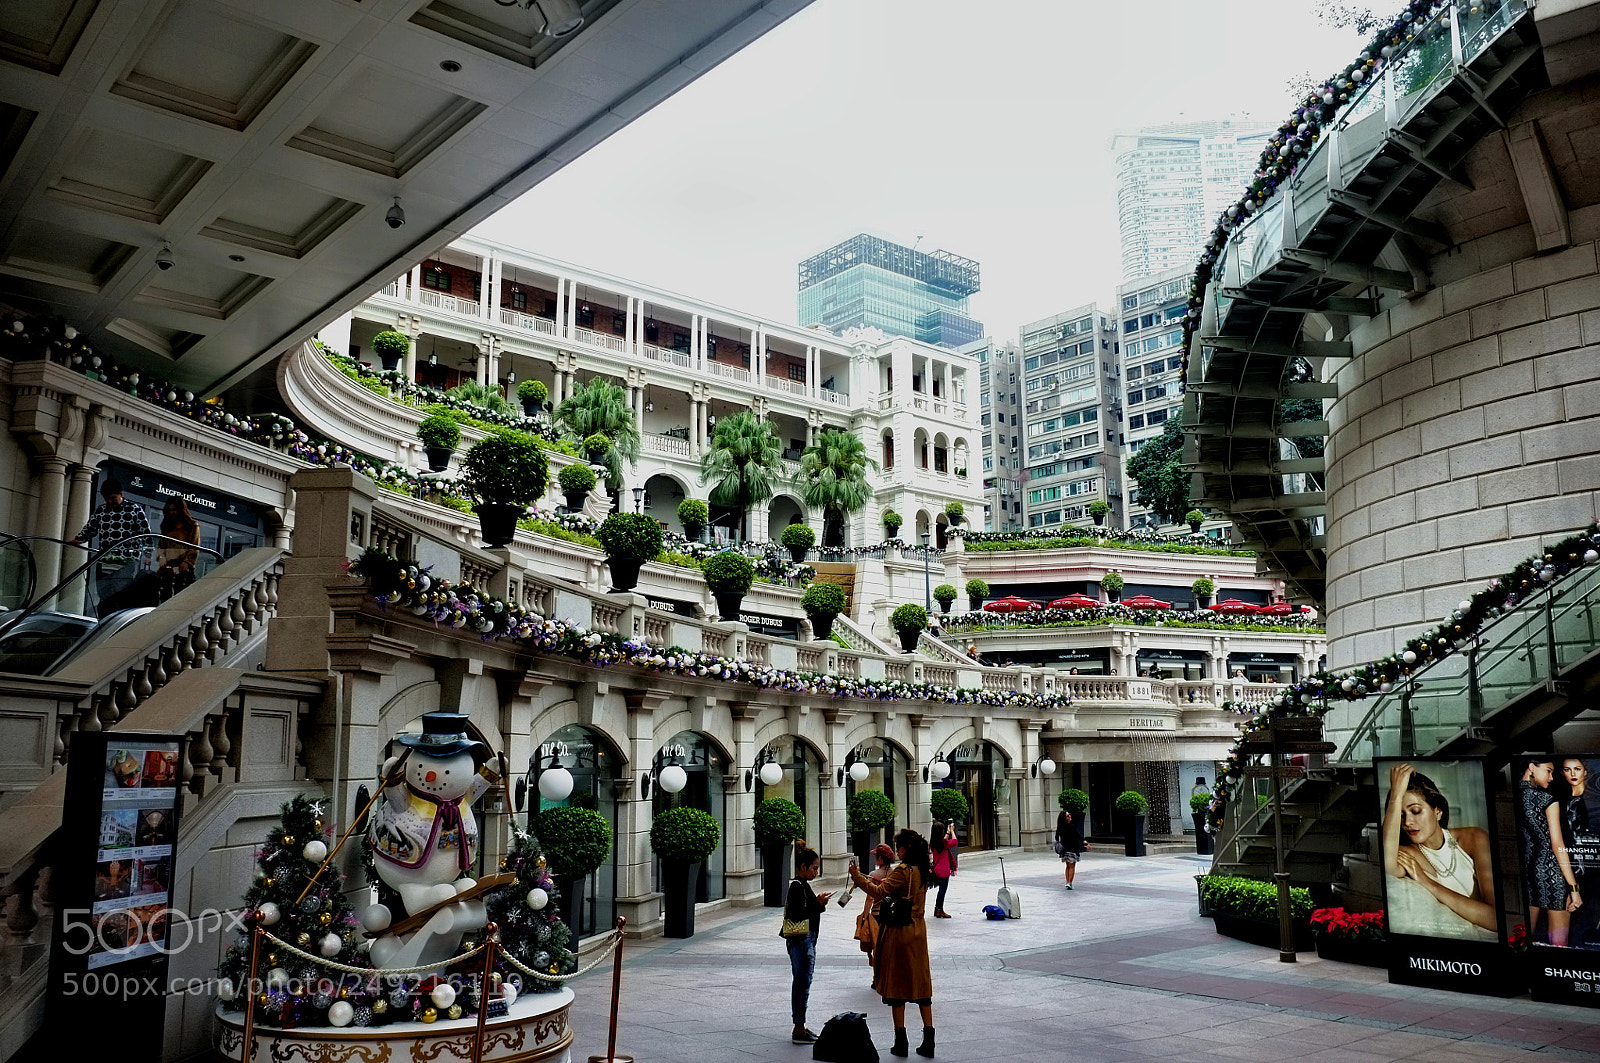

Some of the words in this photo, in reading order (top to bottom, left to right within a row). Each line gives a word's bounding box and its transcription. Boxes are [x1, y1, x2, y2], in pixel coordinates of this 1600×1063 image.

[650, 600, 675, 612] DUBUIS
[739, 614, 760, 625] ROGER
[761, 617, 783, 627] DUBUIS
[1132, 687, 1149, 695] 1881
[1130, 718, 1164, 727] HERITAGE
[1557, 846, 1598, 854] SHANGHAI
[1409, 956, 1482, 976] MIKIMOTO
